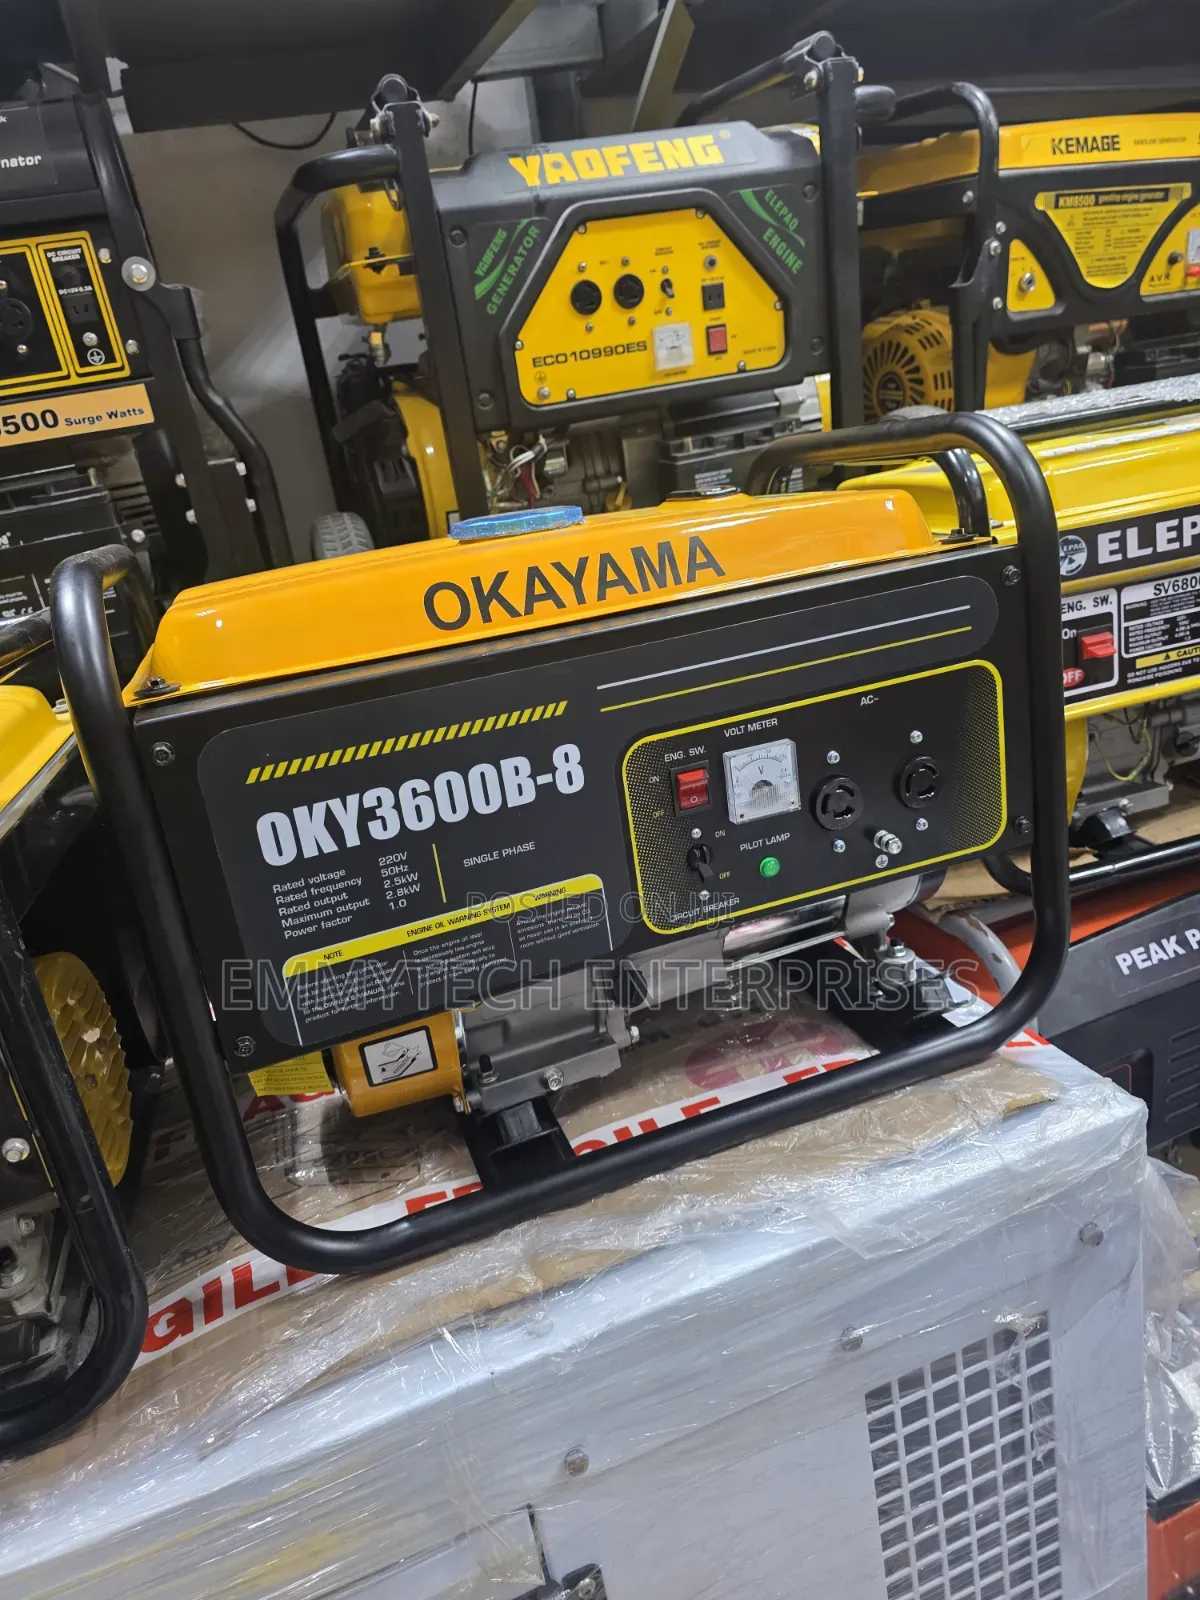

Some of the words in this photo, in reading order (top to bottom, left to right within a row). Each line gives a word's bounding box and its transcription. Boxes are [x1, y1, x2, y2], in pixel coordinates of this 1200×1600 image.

[1052, 134, 1121, 156] KEMAGE
[508, 134, 724, 187] YAOFENG
[764, 188, 799, 233] ELEPAQ
[51, 254, 81, 263] BREAKER
[57, 248, 82, 257] CIRCUIT
[763, 227, 803, 274] ENGINE
[486, 225, 541, 315] GENERATOR
[0, 409, 59, 436] 500
[64, 414, 103, 427] Surge
[105, 406, 145, 420] Watts
[1097, 515, 1200, 564] ELEP
[423, 535, 726, 631] OKAYAMA
[1153, 576, 1200, 597] SV680
[1093, 595, 1113, 608] SW.
[724, 725, 745, 738] VOLT
[747, 718, 779, 732] METER
[664, 750, 687, 763] ENG.
[688, 746, 707, 757] SW.
[648, 775, 660, 783] ON
[256, 743, 585, 866] OKY3600B-8
[652, 809, 665, 818] OFF
[714, 829, 726, 838] ON
[739, 839, 763, 852] PILOT
[765, 832, 791, 845] LAMP
[463, 850, 499, 868] SINGLE
[502, 841, 536, 857] PHASE
[273, 878, 305, 893] Rated
[307, 869, 346, 884] voltage
[378, 851, 408, 866] 220V
[719, 871, 731, 880] OFF
[275, 890, 308, 905] Rated
[310, 877, 362, 896] frequency
[380, 864, 409, 878] 50Hz
[278, 901, 311, 917] Rated
[313, 892, 349, 907] output
[383, 872, 419, 889] 2.5kW
[534, 887, 567, 901] WARNING
[281, 909, 333, 928] Maximum
[336, 898, 370, 913] output
[386, 883, 421, 900] 2.8kW
[669, 907, 700, 922] CIRCUIT
[702, 897, 740, 913] BREAKER
[284, 924, 318, 940] Power
[320, 916, 353, 929] factor
[388, 899, 408, 910] 1.0
[406, 924, 433, 938] ENGINE
[434, 921, 446, 929] OIL
[447, 911, 482, 926] WARNING
[482, 902, 511, 916] SYSTEM
[323, 949, 343, 960] NOTE
[413, 948, 428, 956] Once
[429, 944, 440, 952] the
[441, 939, 461, 948] engine
[469, 932, 483, 940] level
[421, 948, 454, 963] excessively
[471, 947, 482, 955] will
[483, 945, 496, 953] stop
[1115, 934, 1187, 976] PEAK
[297, 980, 319, 992] Before
[320, 973, 345, 985] starting
[420, 977, 442, 988] protect
[464, 964, 480, 974] being
[301, 998, 315, 1007] with
[312, 1004, 323, 1012] the
[357, 986, 386, 998] MANUAL
[305, 1011, 330, 1024] product
